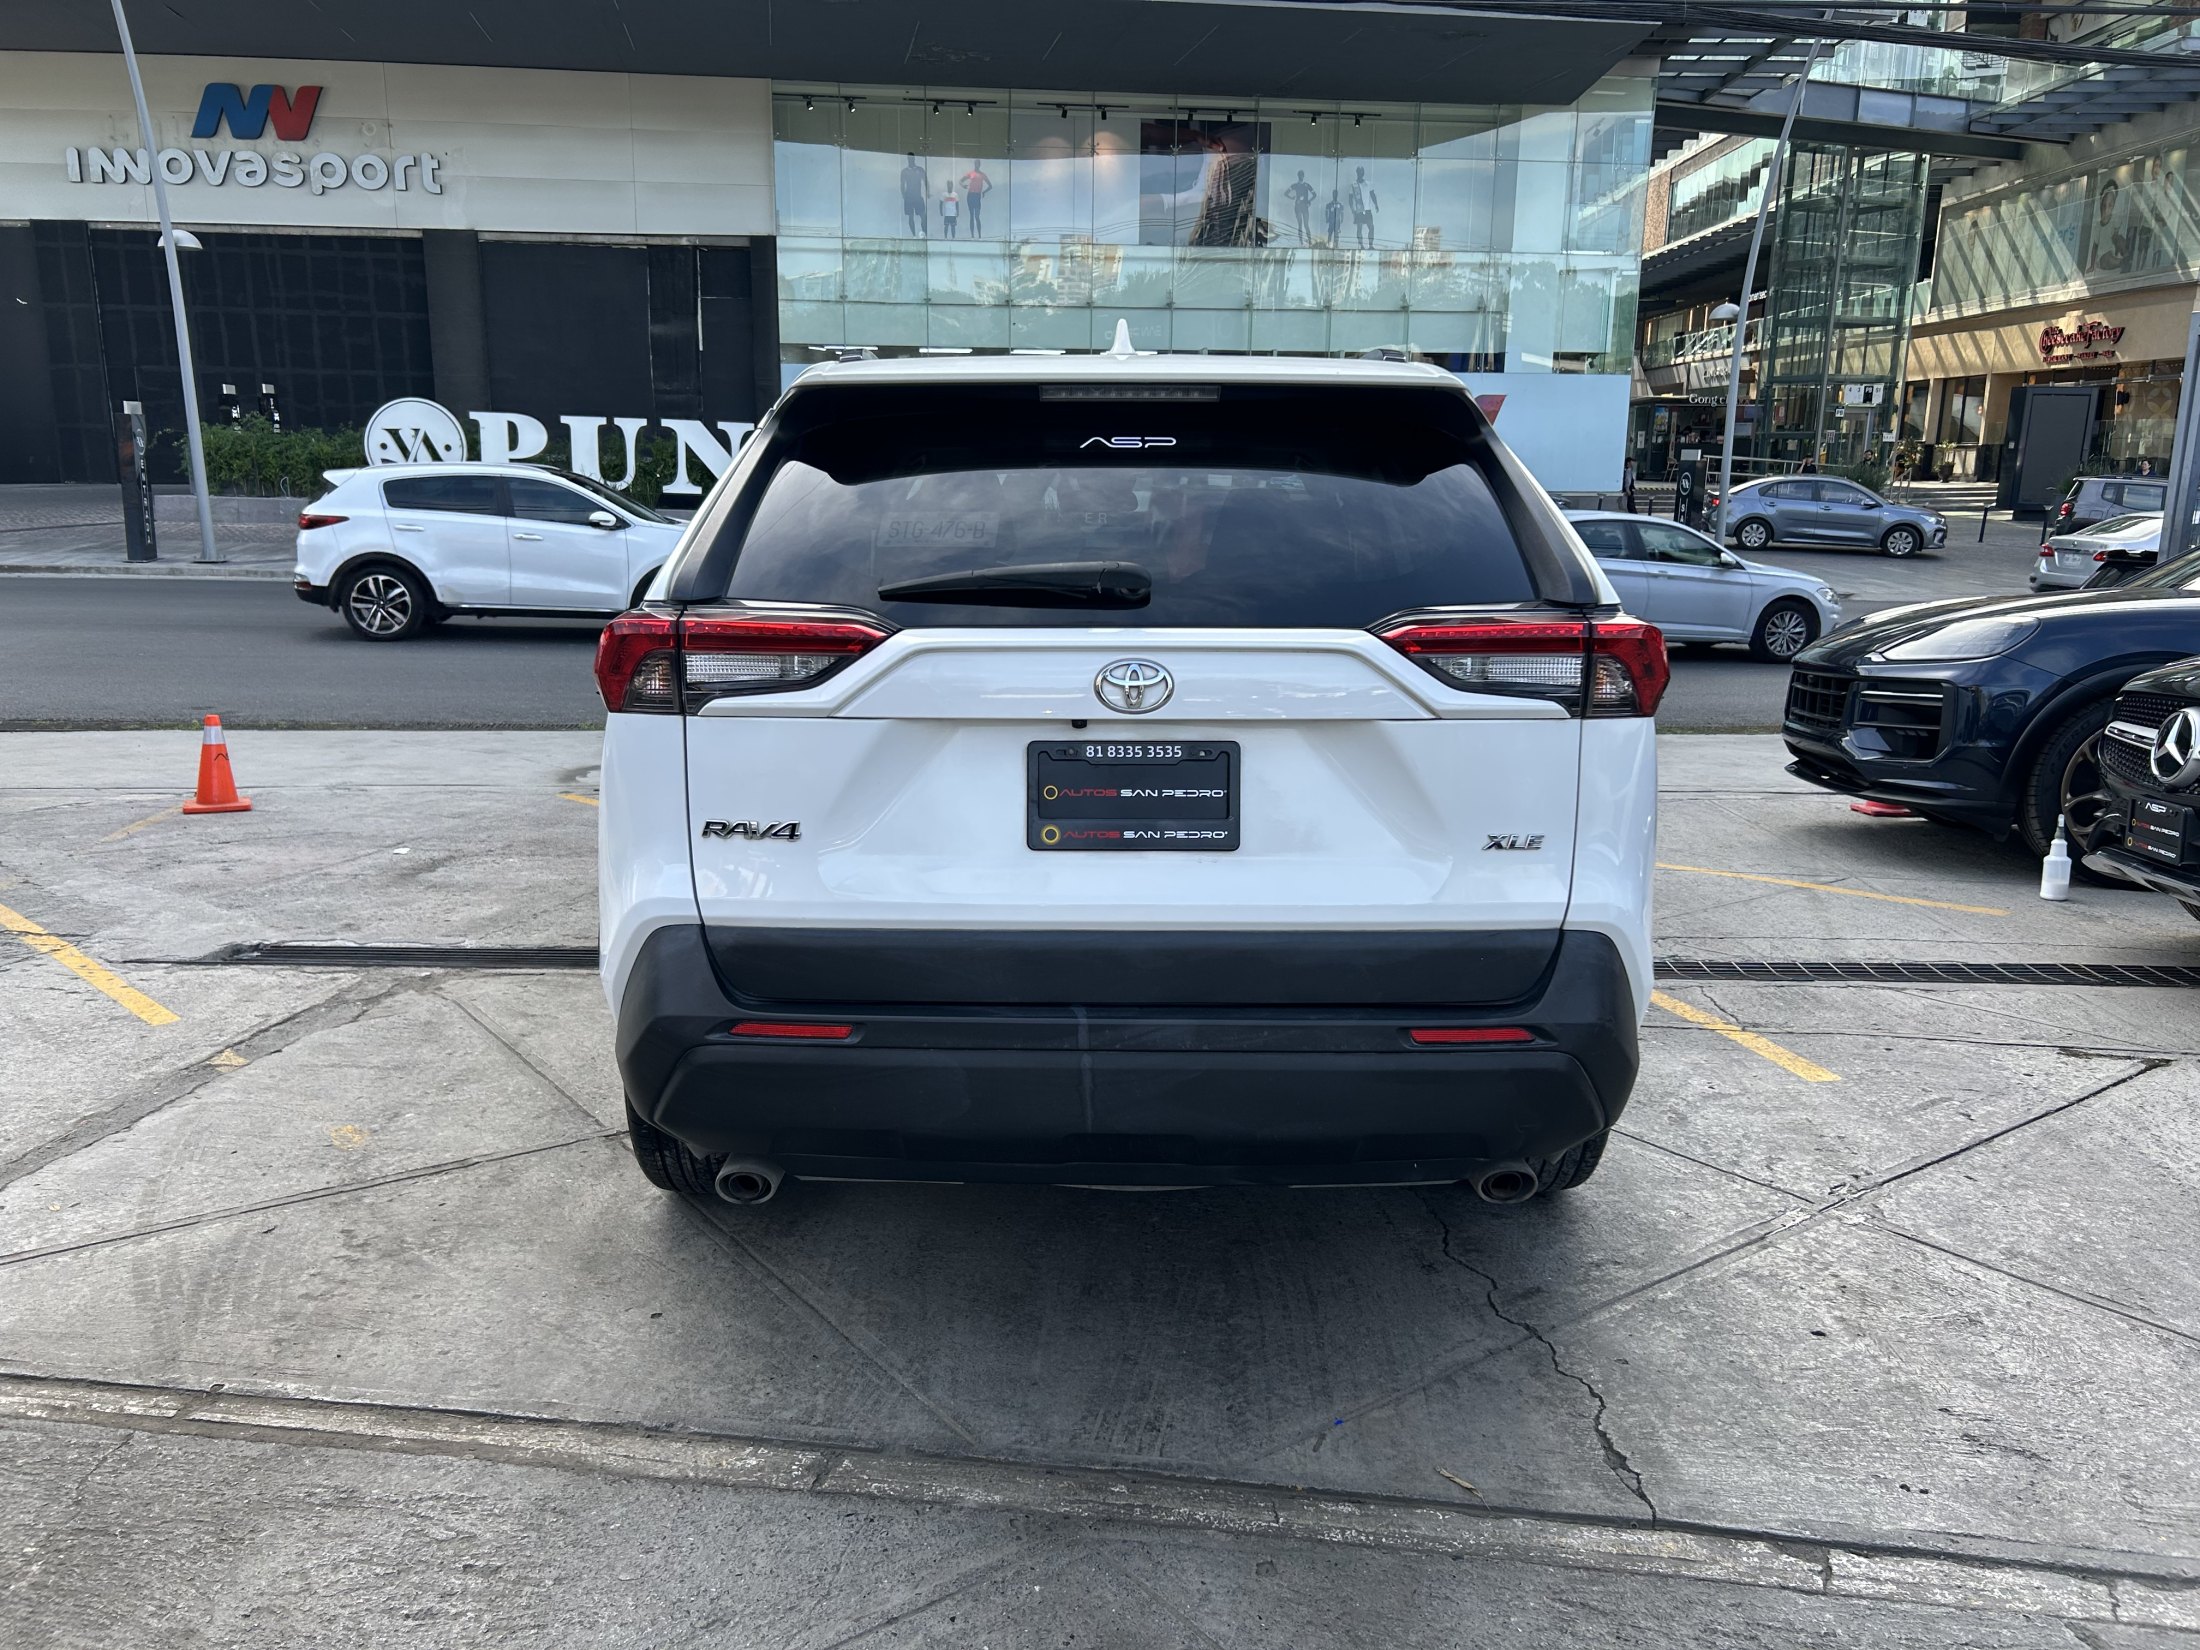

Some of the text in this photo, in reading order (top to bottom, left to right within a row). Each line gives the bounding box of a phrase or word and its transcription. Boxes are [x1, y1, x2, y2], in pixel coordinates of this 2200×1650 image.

[1689, 394, 1718, 408] Gong
[1086, 745, 1183, 758] 81 8335 3535
[1059, 788, 1118, 797] AUTOS
[1120, 788, 1158, 797] SAN
[702, 819, 801, 841] RAV4
[1063, 831, 1120, 839] AUTOS
[1123, 831, 1160, 839] SAN
[1482, 834, 1545, 850] XLE
